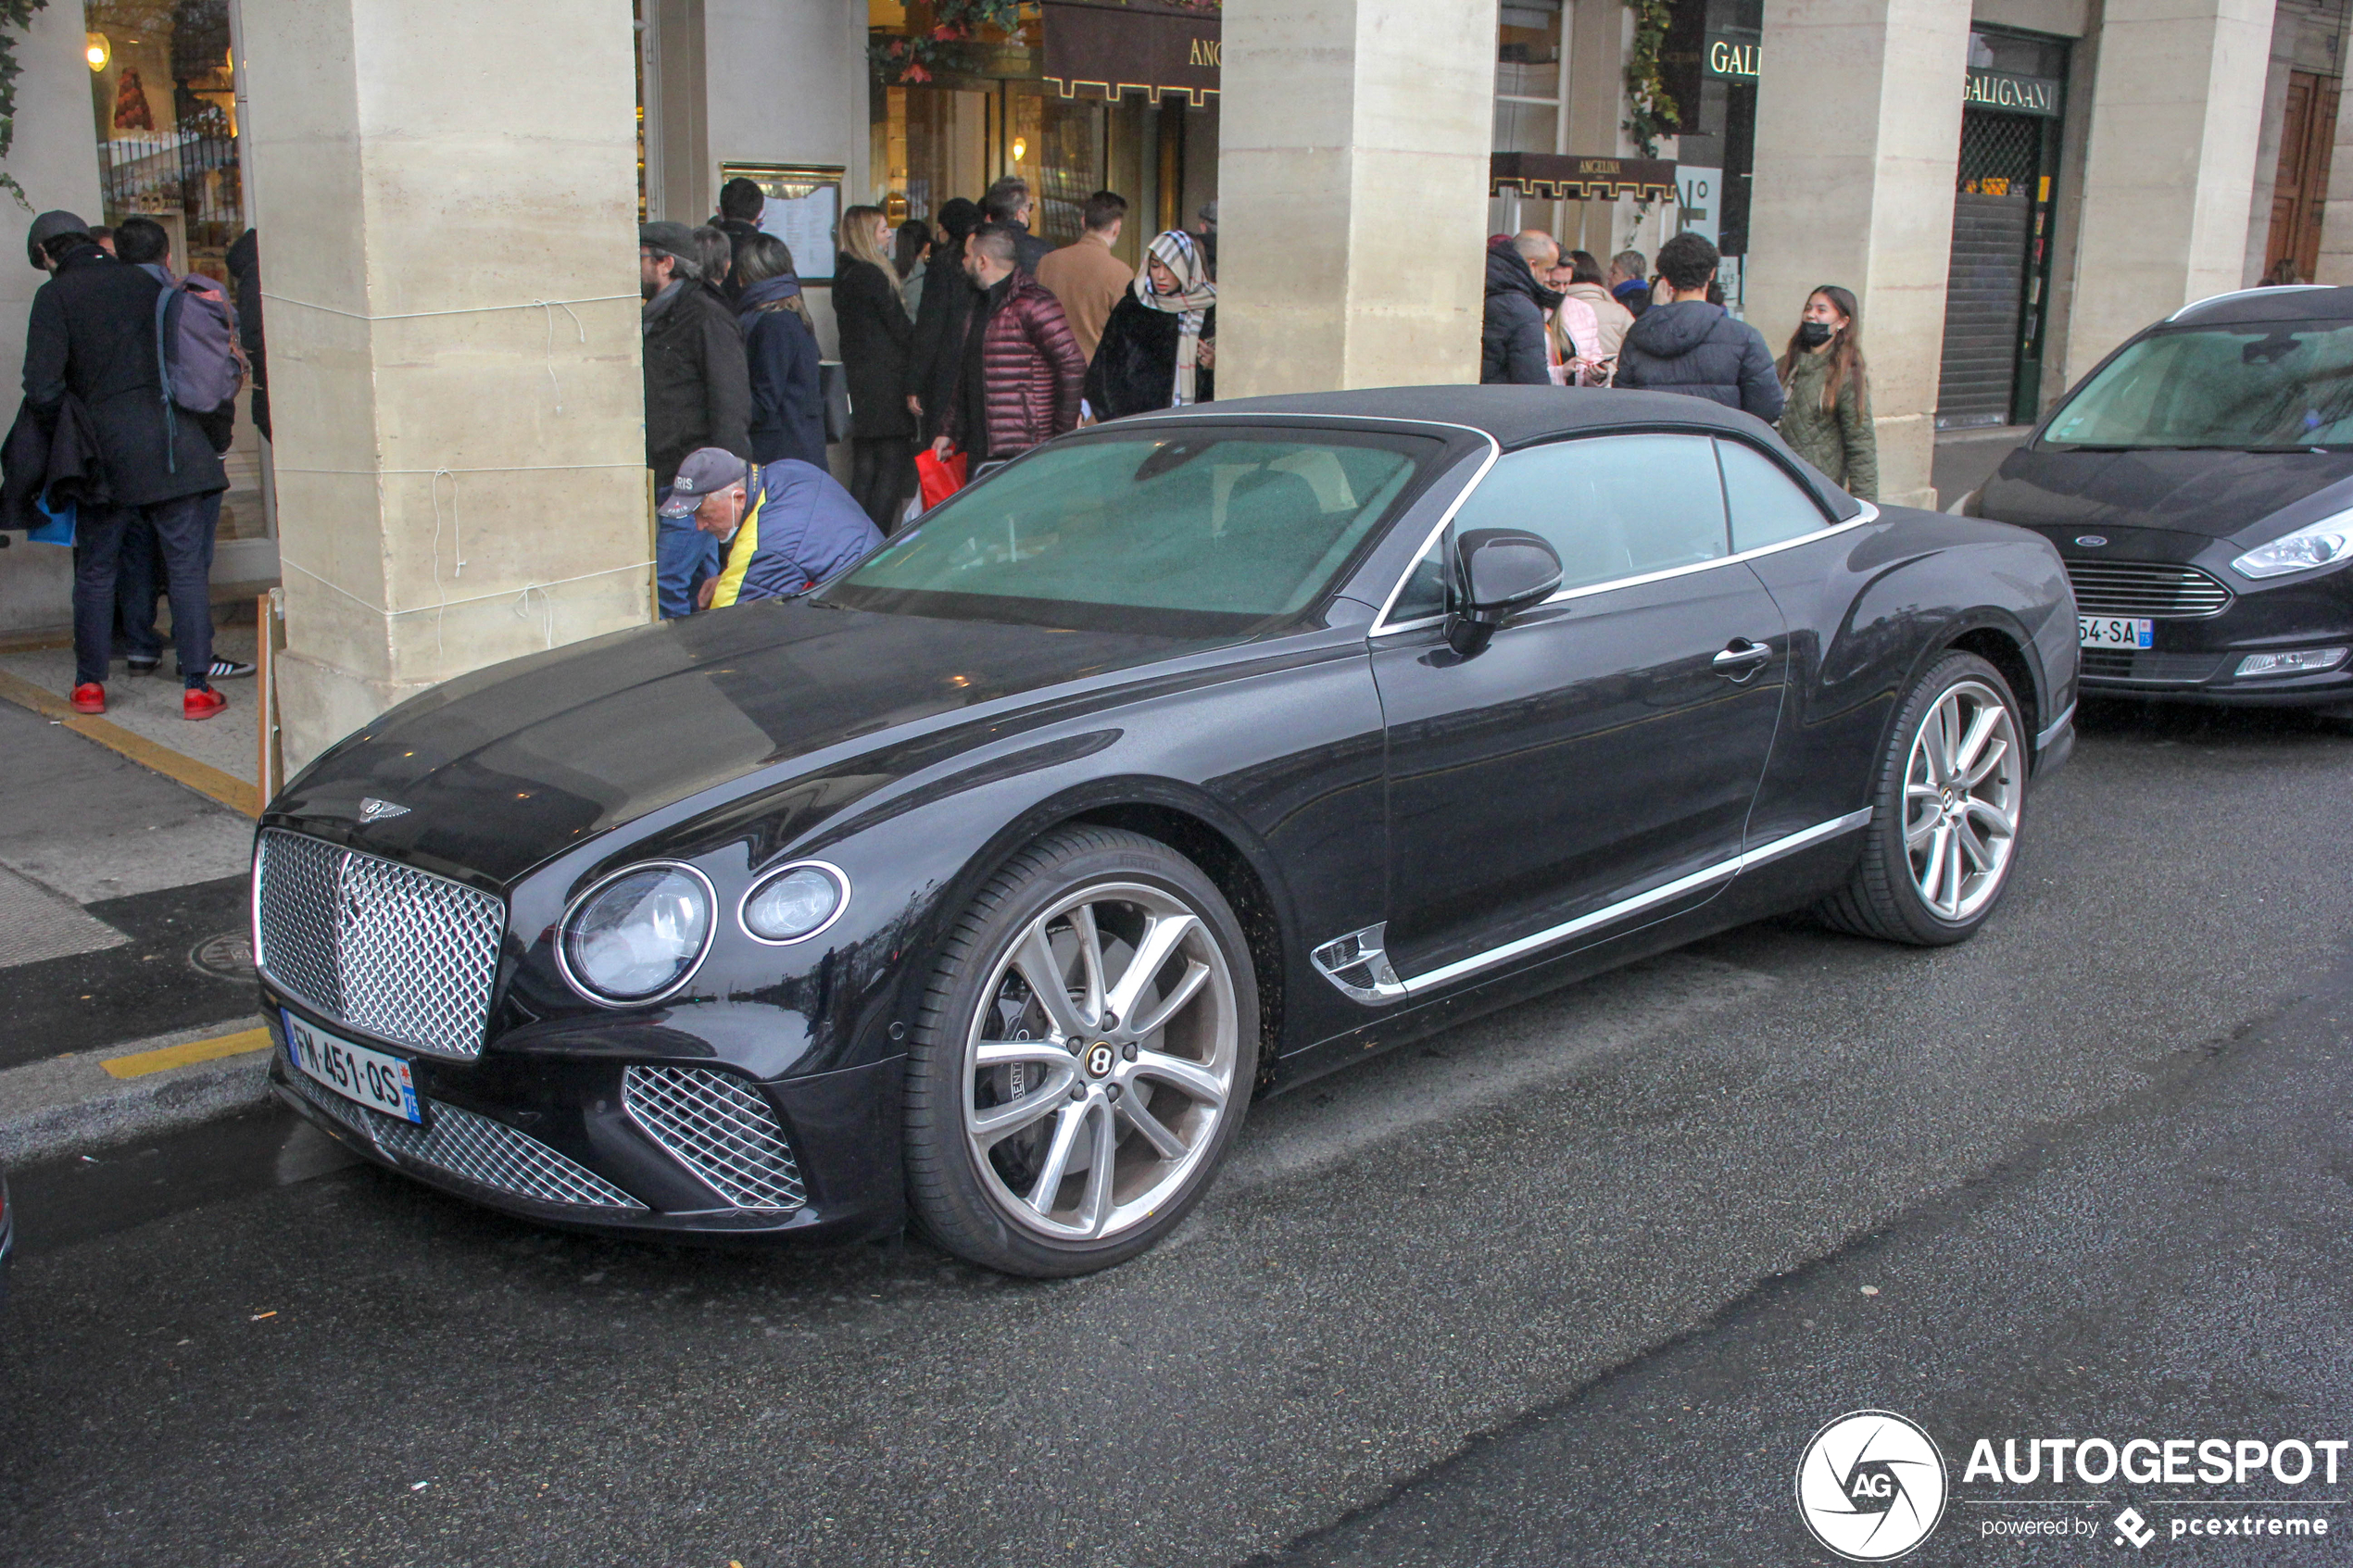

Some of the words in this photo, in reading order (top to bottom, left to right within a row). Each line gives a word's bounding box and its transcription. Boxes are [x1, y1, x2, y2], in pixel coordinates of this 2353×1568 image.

[2079, 619, 2135, 644] 54-SA
[2141, 633, 2150, 645] 75
[293, 1022, 401, 1108] FM-451-QS
[404, 1092, 420, 1116] 75
